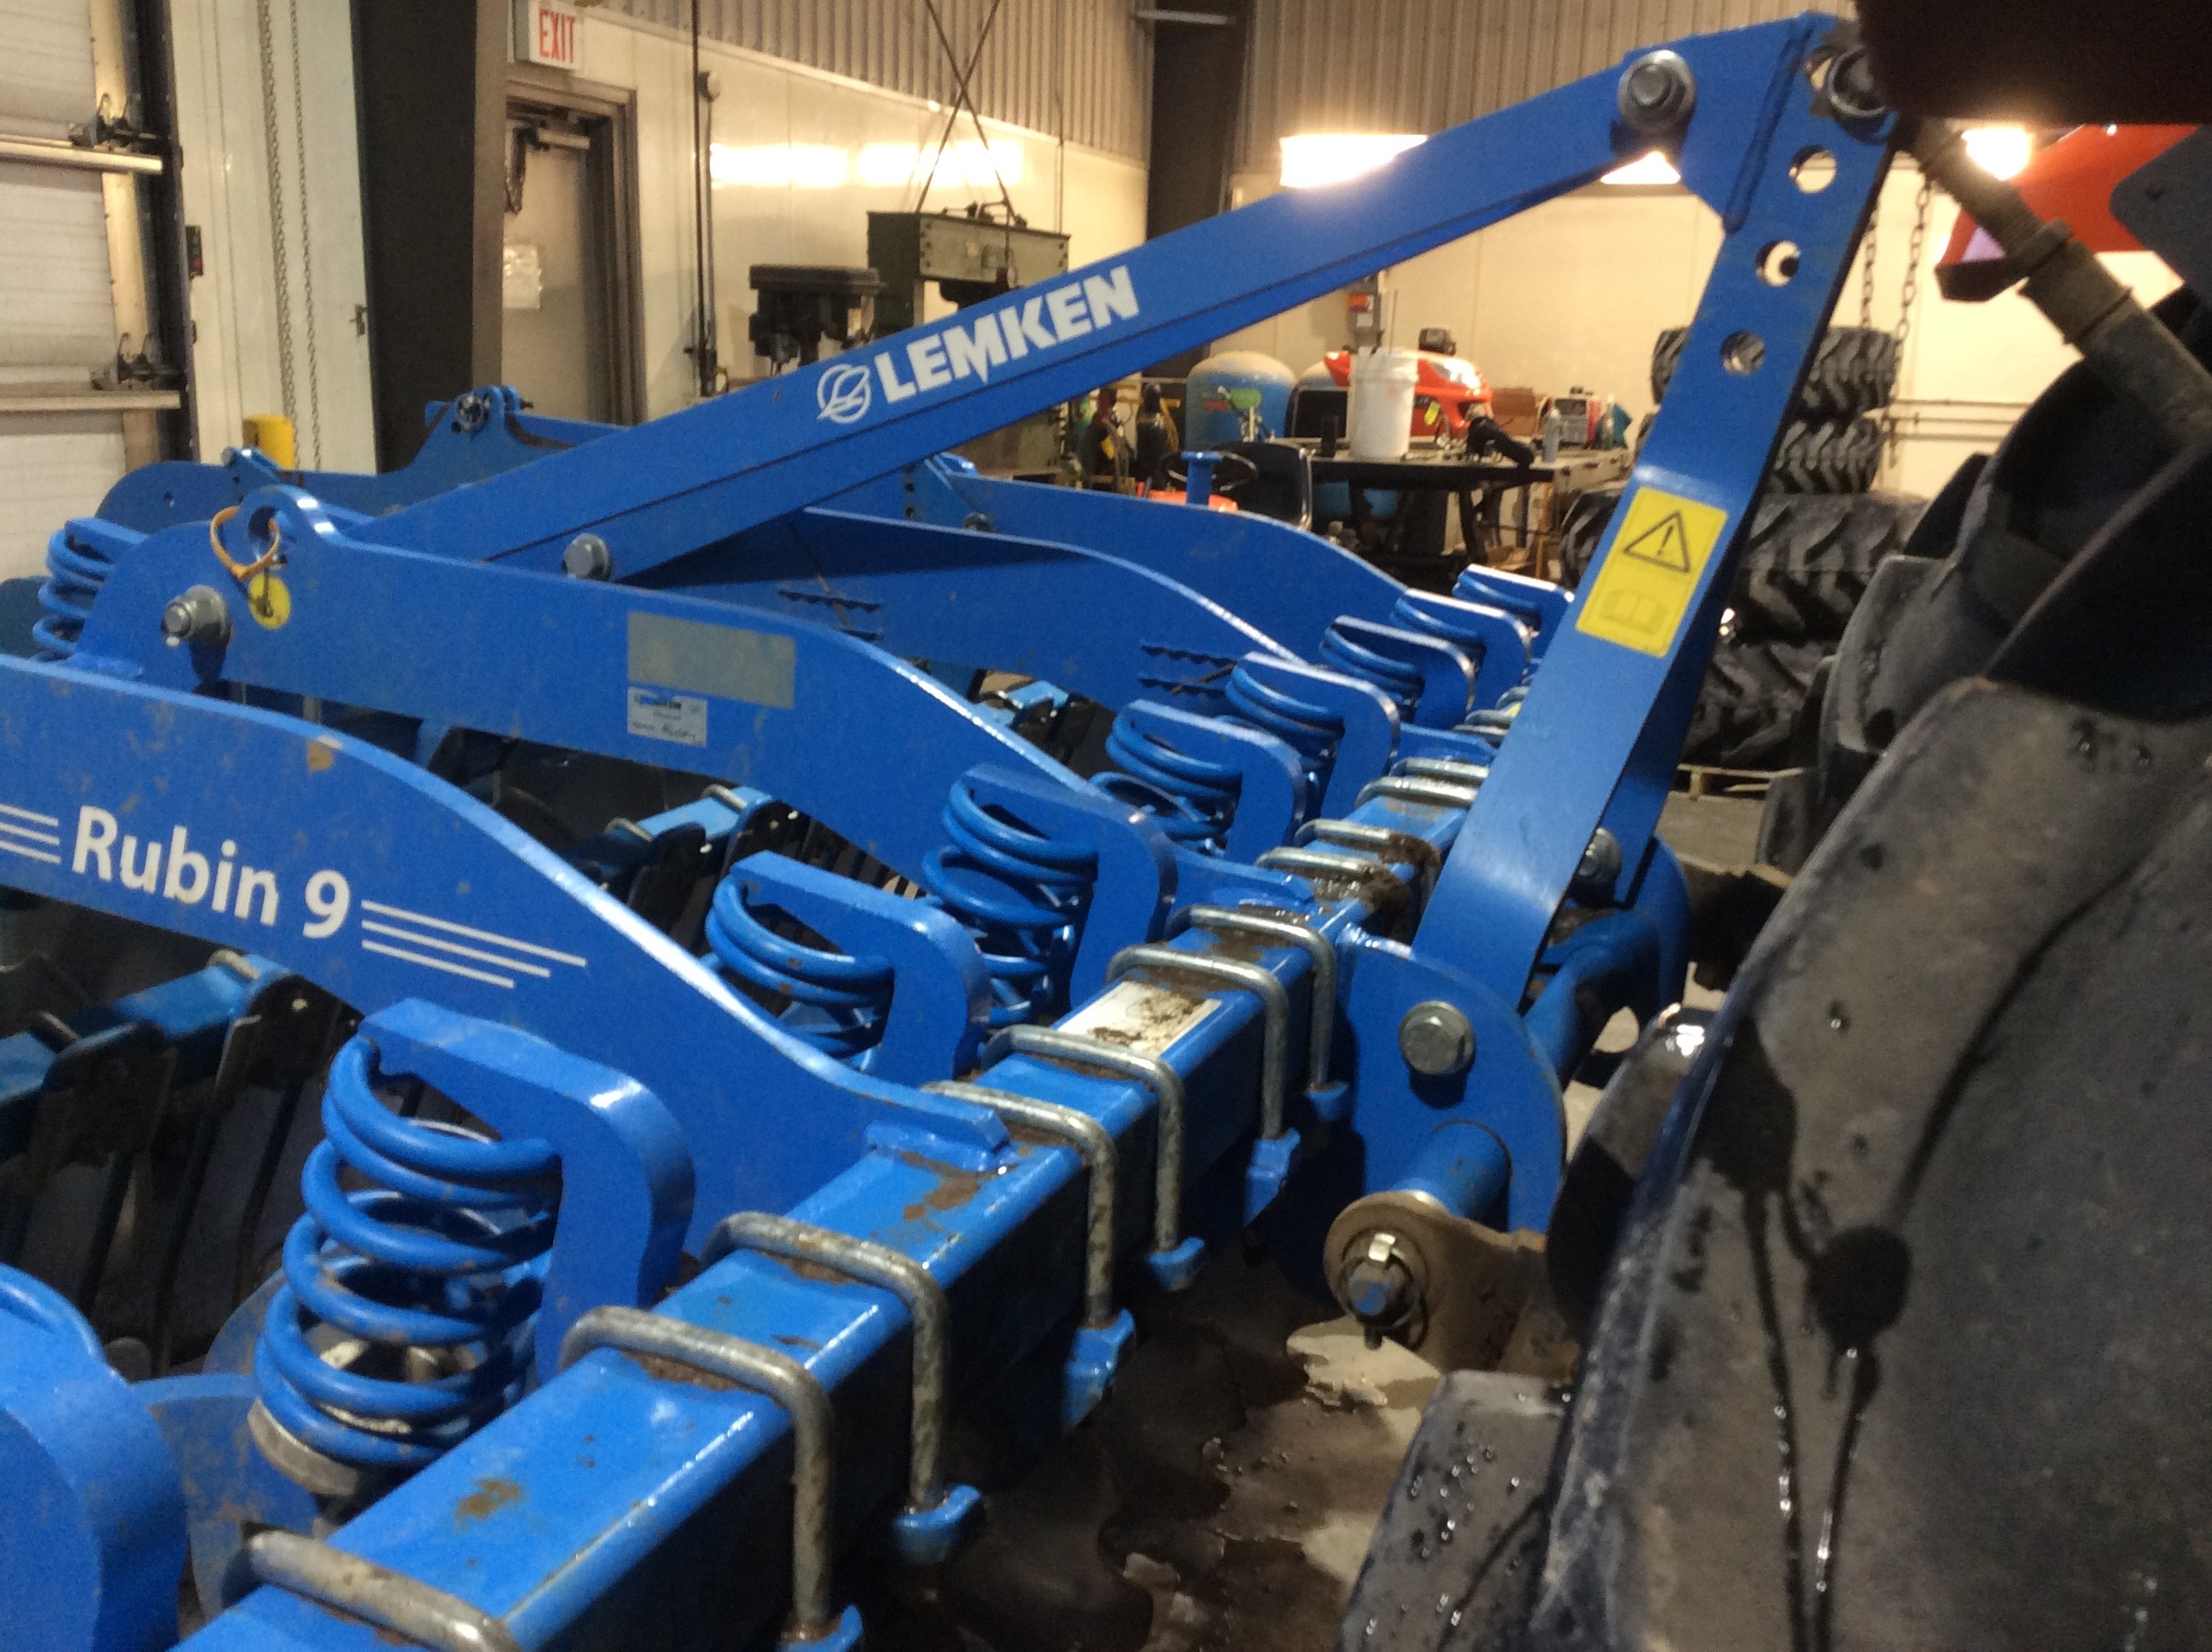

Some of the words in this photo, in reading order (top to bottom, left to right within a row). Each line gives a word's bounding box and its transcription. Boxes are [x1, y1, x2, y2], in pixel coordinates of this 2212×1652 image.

[539, 9, 575, 63] EXIT
[875, 265, 1139, 403] LEMKEN
[72, 805, 279, 927] Rubin
[302, 869, 352, 939] 9
